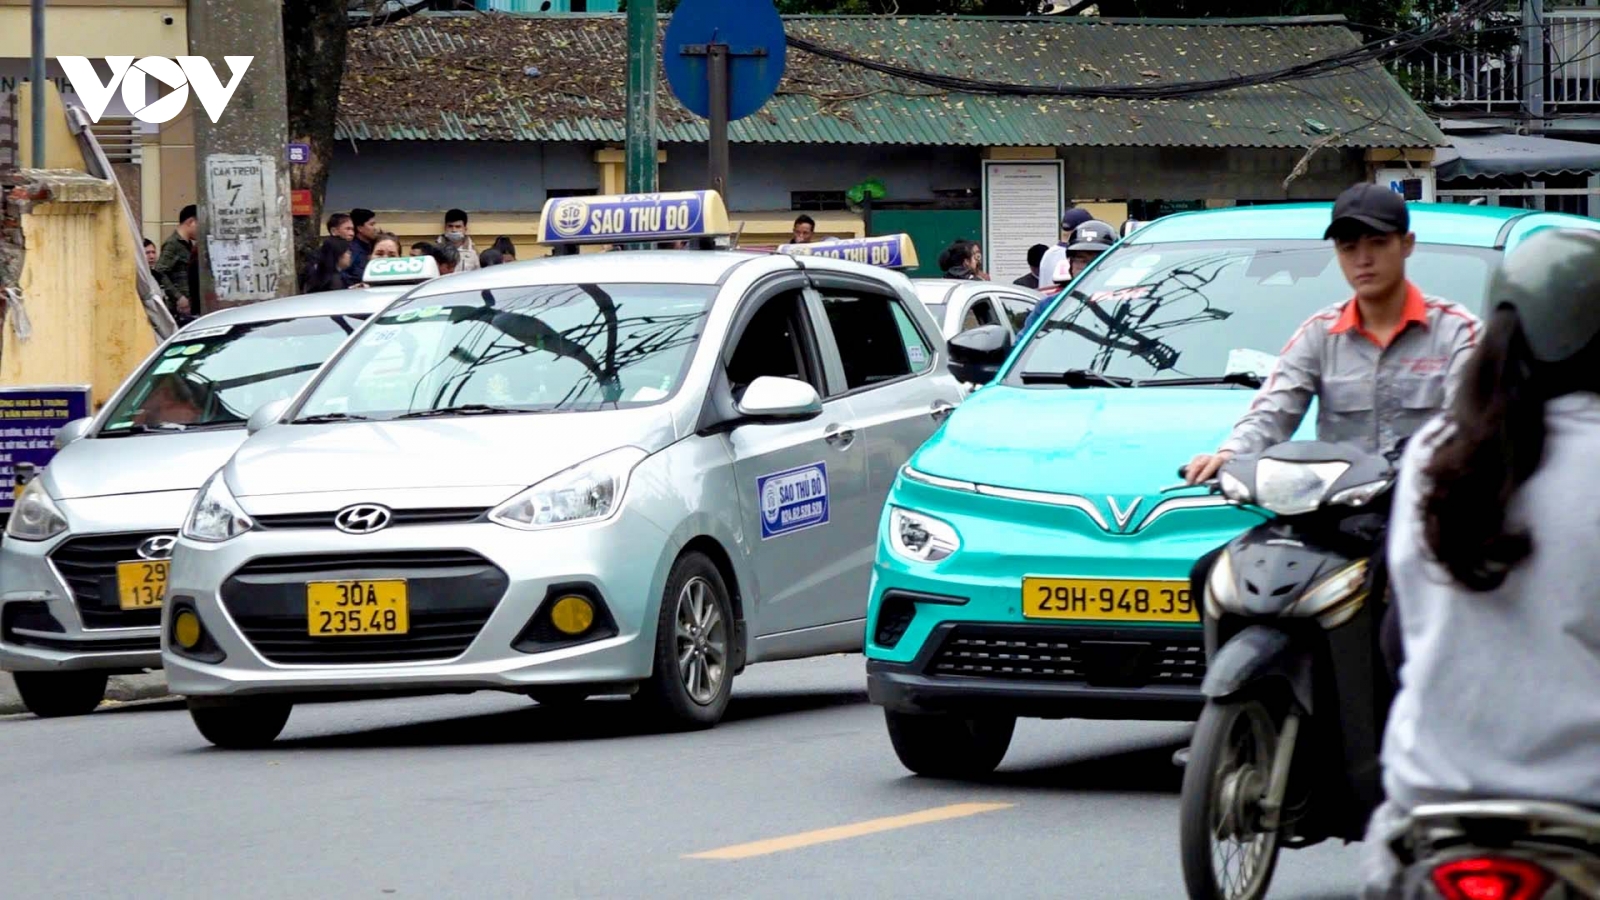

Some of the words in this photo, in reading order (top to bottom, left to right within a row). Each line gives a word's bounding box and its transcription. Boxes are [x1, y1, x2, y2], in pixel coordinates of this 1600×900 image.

[590, 208, 626, 235] SAO
[629, 200, 661, 233] THỦ
[665, 201, 689, 231] ĐÔ
[370, 257, 424, 273] Grab
[872, 242, 890, 265] ĐÔ
[779, 483, 794, 503] SAO
[336, 584, 378, 606] 30A
[1038, 586, 1193, 614] 29H-948.39
[319, 609, 397, 633] 235.48
